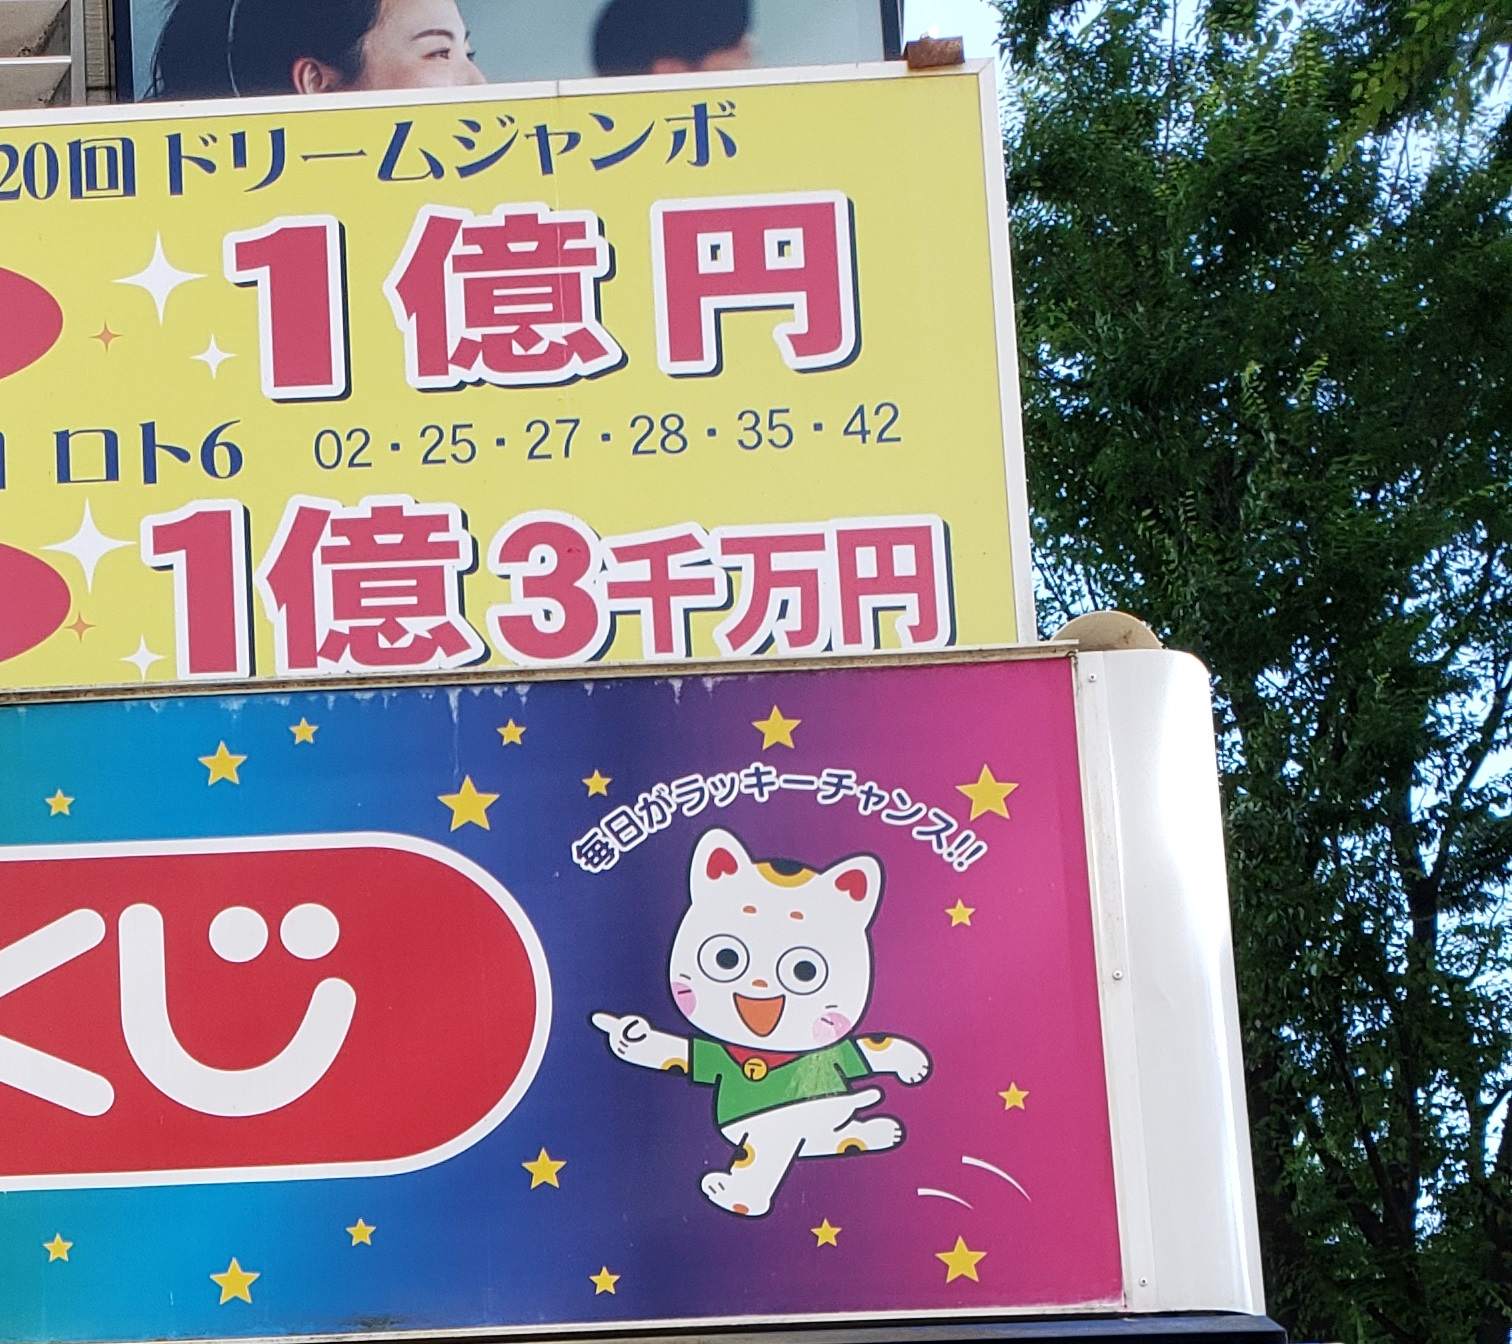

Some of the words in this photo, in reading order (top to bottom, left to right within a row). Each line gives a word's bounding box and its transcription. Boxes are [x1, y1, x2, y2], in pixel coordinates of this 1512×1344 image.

[165, 100, 739, 197] ドリームジャンボ
[222, 191, 863, 403] 1億円
[53, 420, 244, 485] ロト6
[140, 494, 958, 681] 1億3千万円
